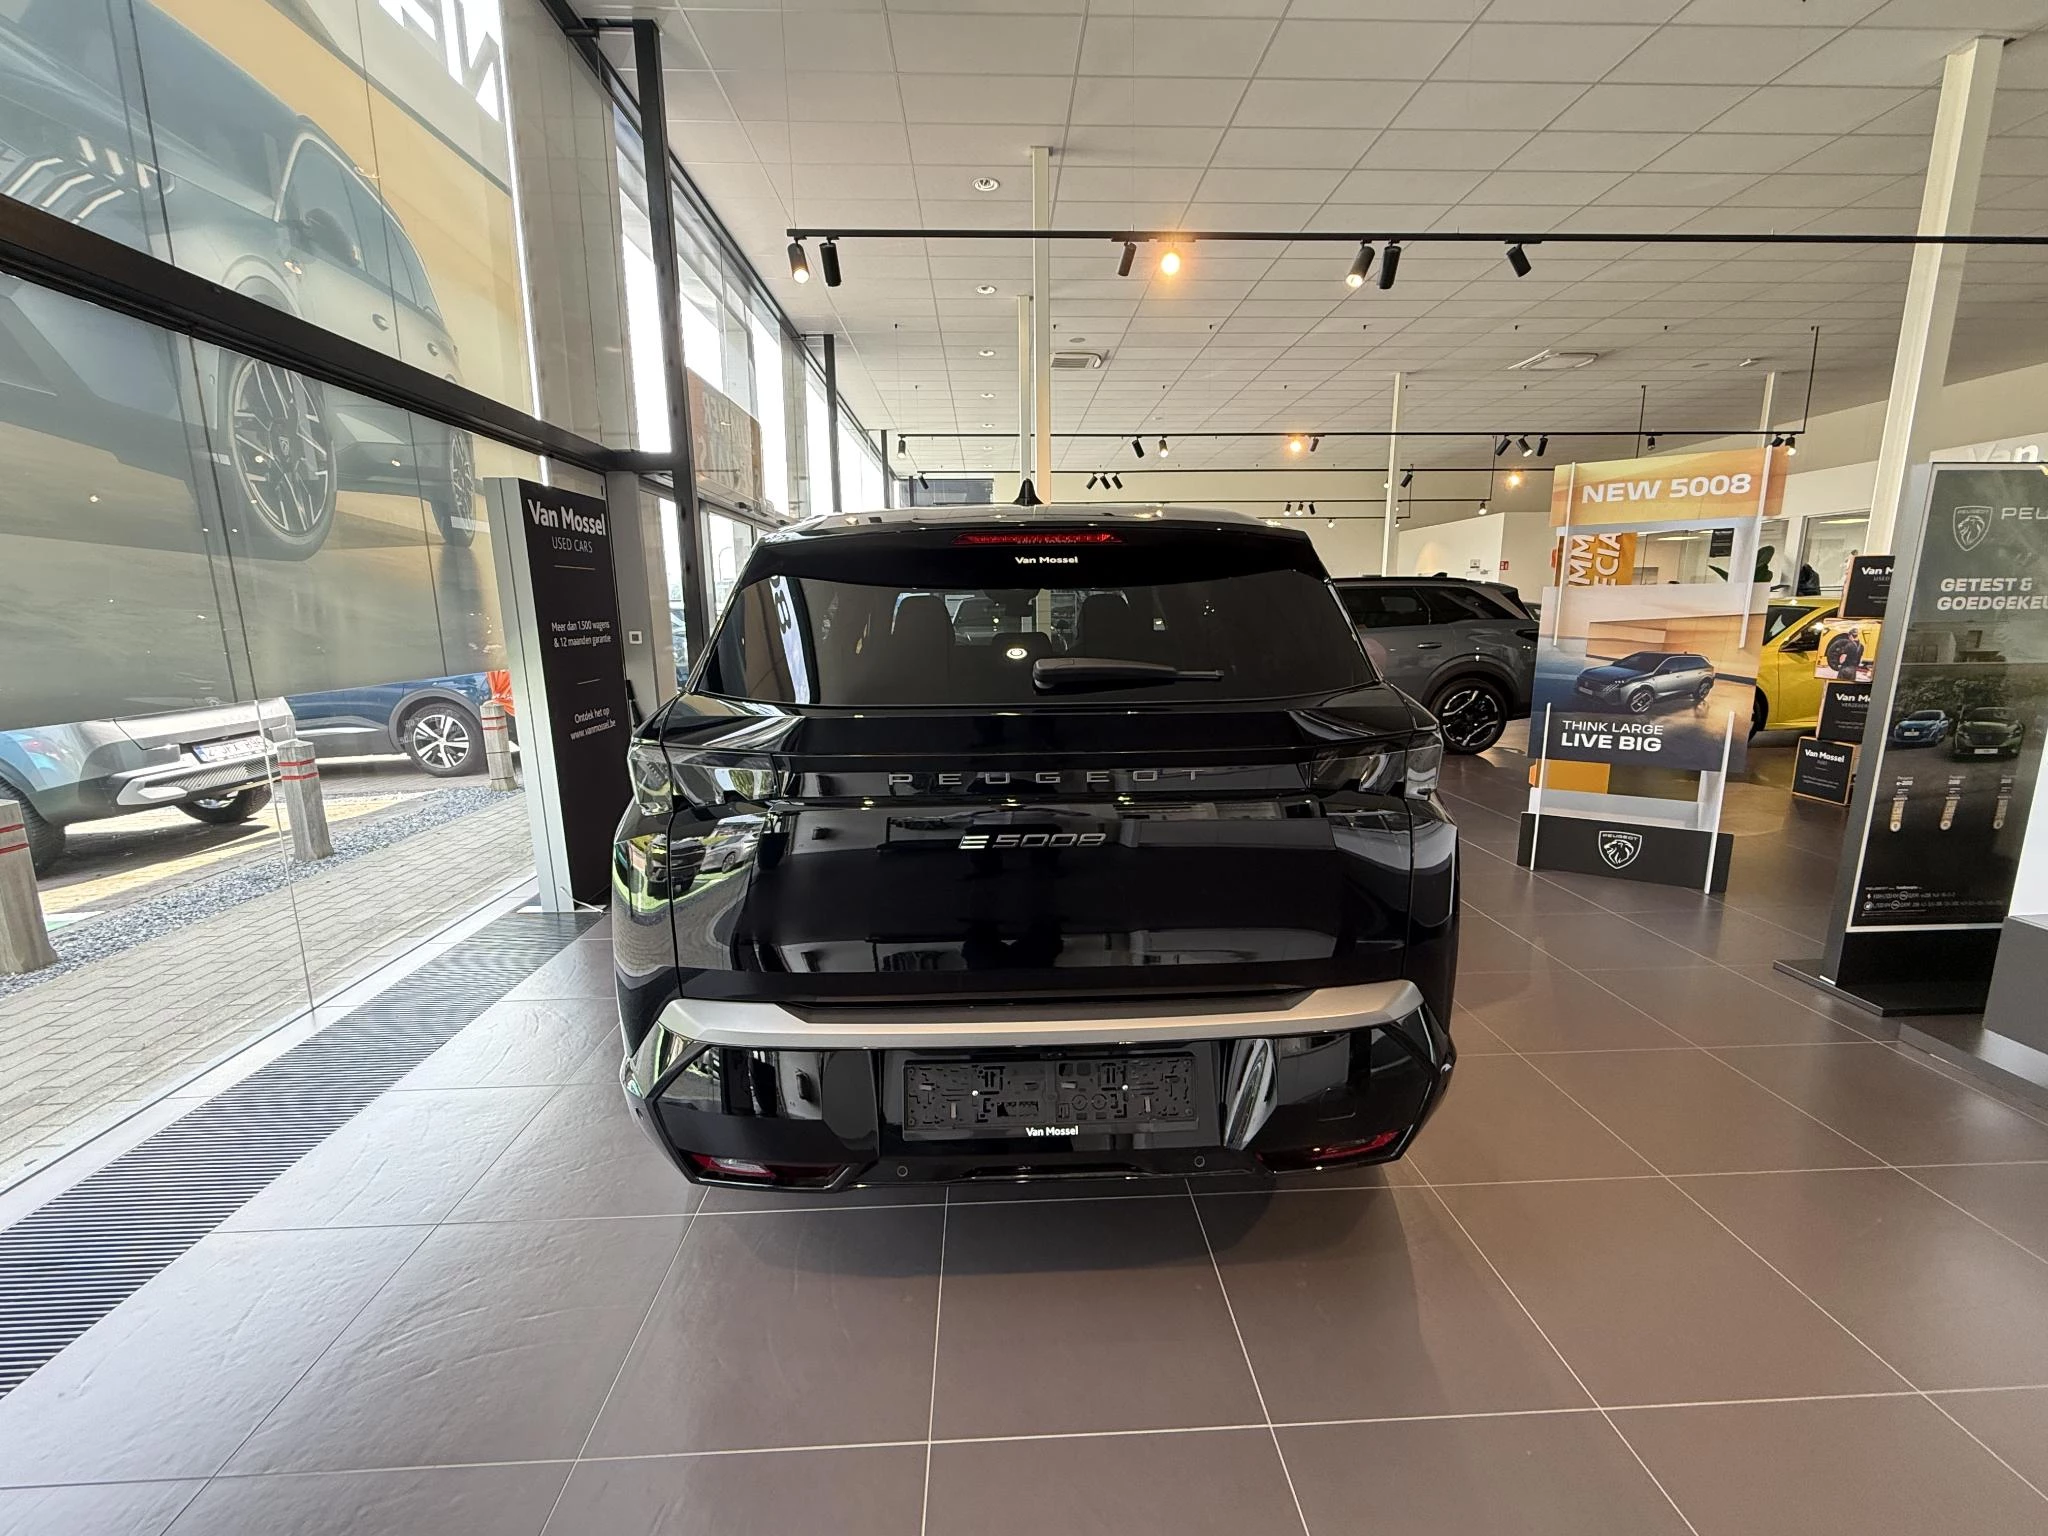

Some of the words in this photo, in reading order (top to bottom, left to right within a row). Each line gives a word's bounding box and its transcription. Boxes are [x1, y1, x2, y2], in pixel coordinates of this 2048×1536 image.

[1581, 480, 1662, 504] NEW
[1669, 473, 1752, 498] 5008
[528, 499, 559, 528] Van
[561, 506, 606, 536] Mossel
[2001, 507, 2048, 520] PEU
[551, 536, 572, 551] USED
[574, 540, 593, 553] CARS
[1015, 556, 1036, 564] Van
[1039, 556, 1078, 564] Mossel
[1861, 567, 1882, 575] Van
[1940, 577, 2017, 592] GETEST
[2019, 577, 2033, 591] &
[551, 622, 566, 632] Meer
[567, 621, 577, 631] dan
[592, 621, 610, 631] wagens
[553, 638, 559, 648] &
[560, 637, 567, 647] 12
[568, 635, 591, 646] maanden
[592, 634, 611, 647] garantie
[1836, 693, 1856, 702] Van
[575, 709, 594, 723] Ontdek
[594, 709, 603, 718] het
[603, 707, 610, 717] op
[570, 719, 616, 740] www.vanmossel.be
[1562, 720, 1608, 732] THINK
[1612, 722, 1664, 735] LARGE
[1561, 733, 1613, 749] LIVE
[1618, 736, 1662, 752] BIG
[1804, 748, 1819, 757] Van
[1819, 751, 1845, 763] Mossel
[888, 769, 1205, 786] PEUGEOT
[1025, 1127, 1044, 1137] Van
[1045, 1125, 1079, 1136] Mossel
